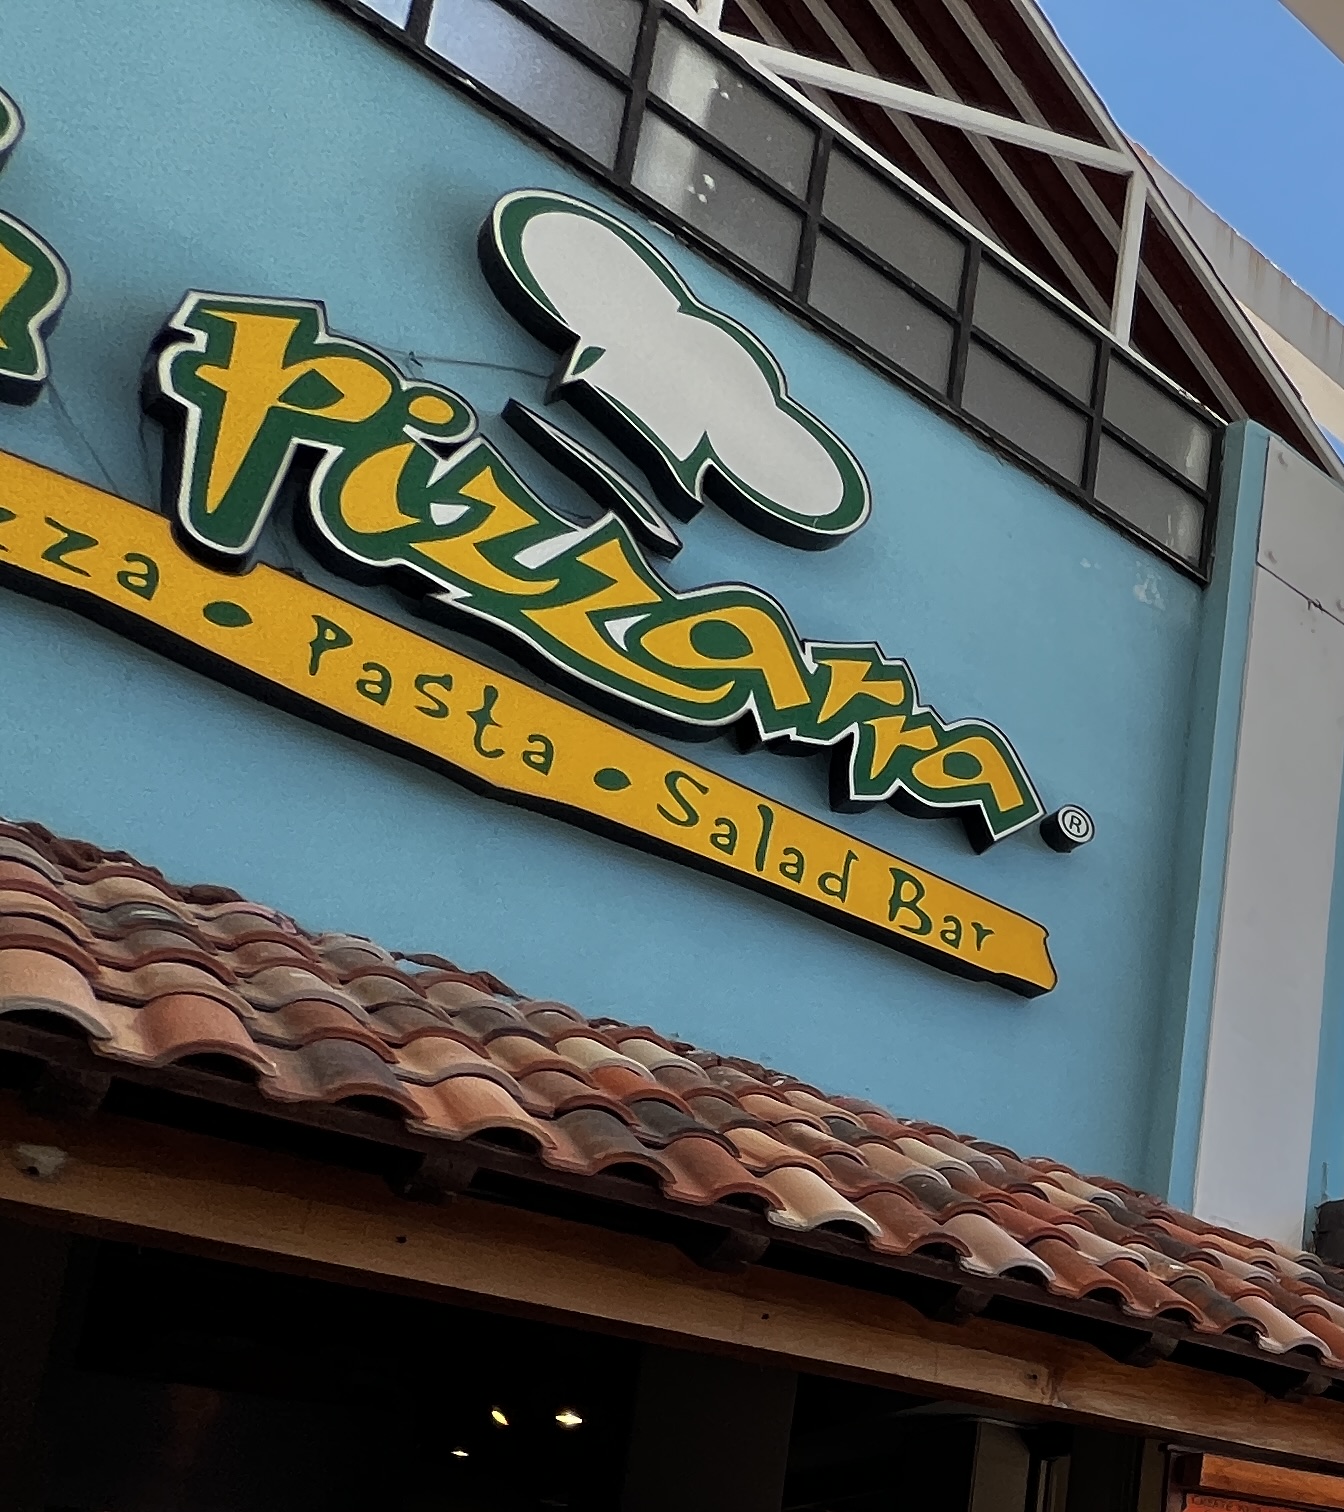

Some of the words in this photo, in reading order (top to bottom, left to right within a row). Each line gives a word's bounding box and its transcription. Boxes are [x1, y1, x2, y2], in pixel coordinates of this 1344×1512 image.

[309, 614, 555, 776] Pasta
[656, 769, 859, 903] Salad
[888, 867, 995, 952] Bar
